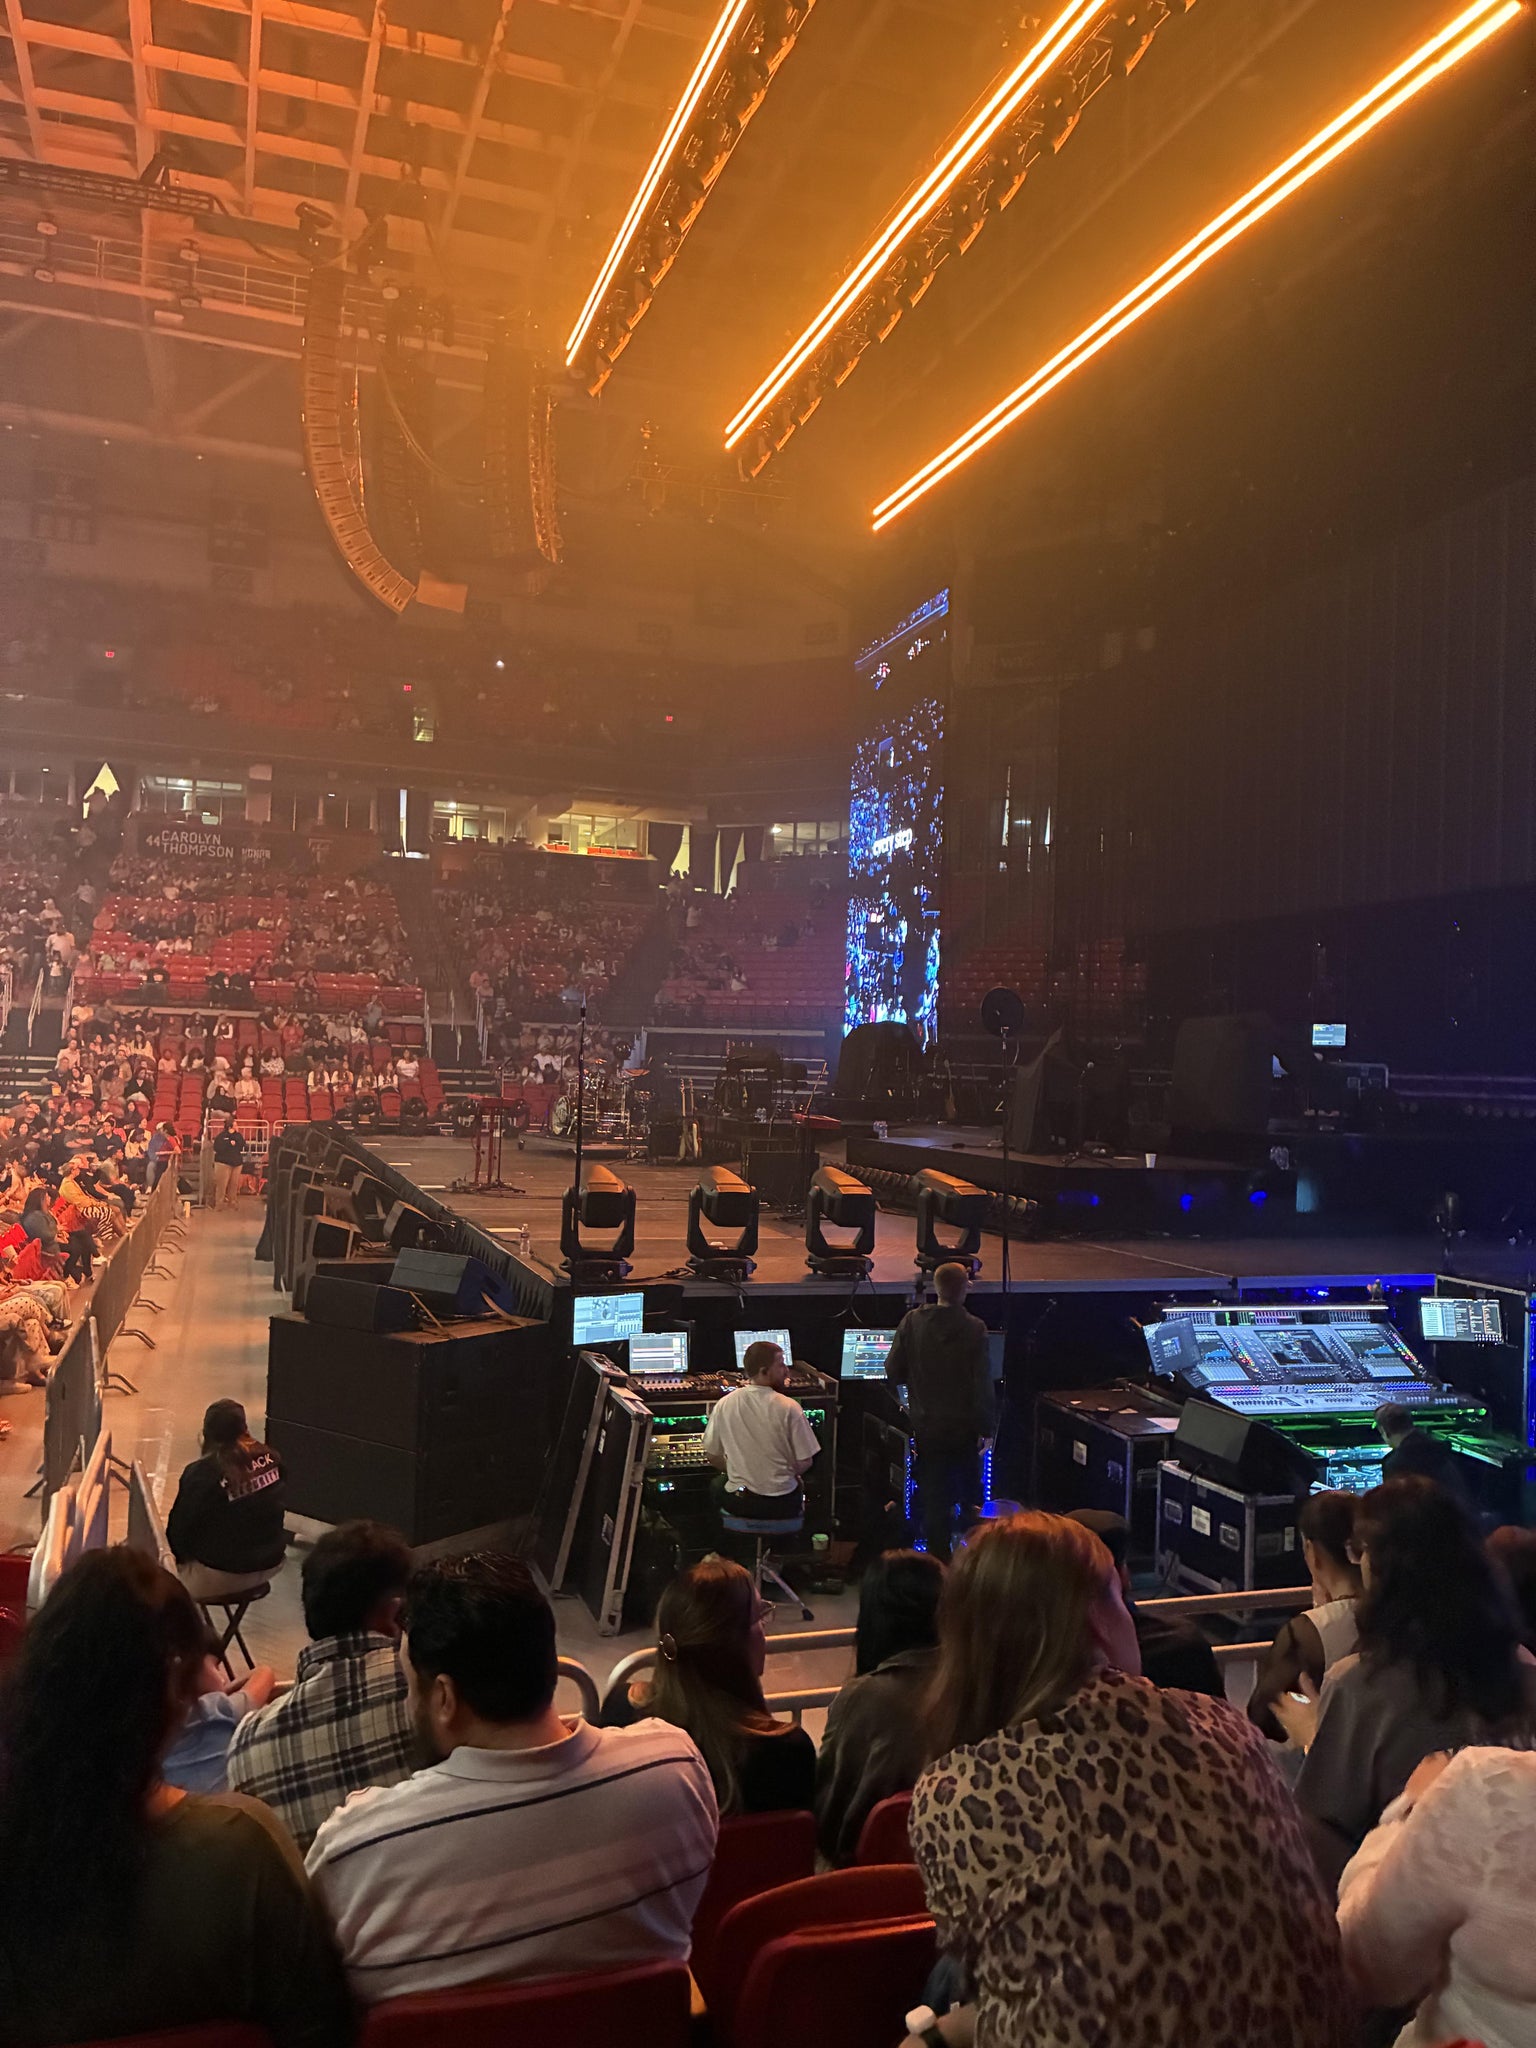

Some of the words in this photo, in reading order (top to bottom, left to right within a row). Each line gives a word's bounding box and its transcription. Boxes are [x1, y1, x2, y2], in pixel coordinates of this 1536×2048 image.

[145, 835, 160, 847] 44
[161, 830, 221, 846] CAROLYN
[162, 842, 234, 859] THOMPSON
